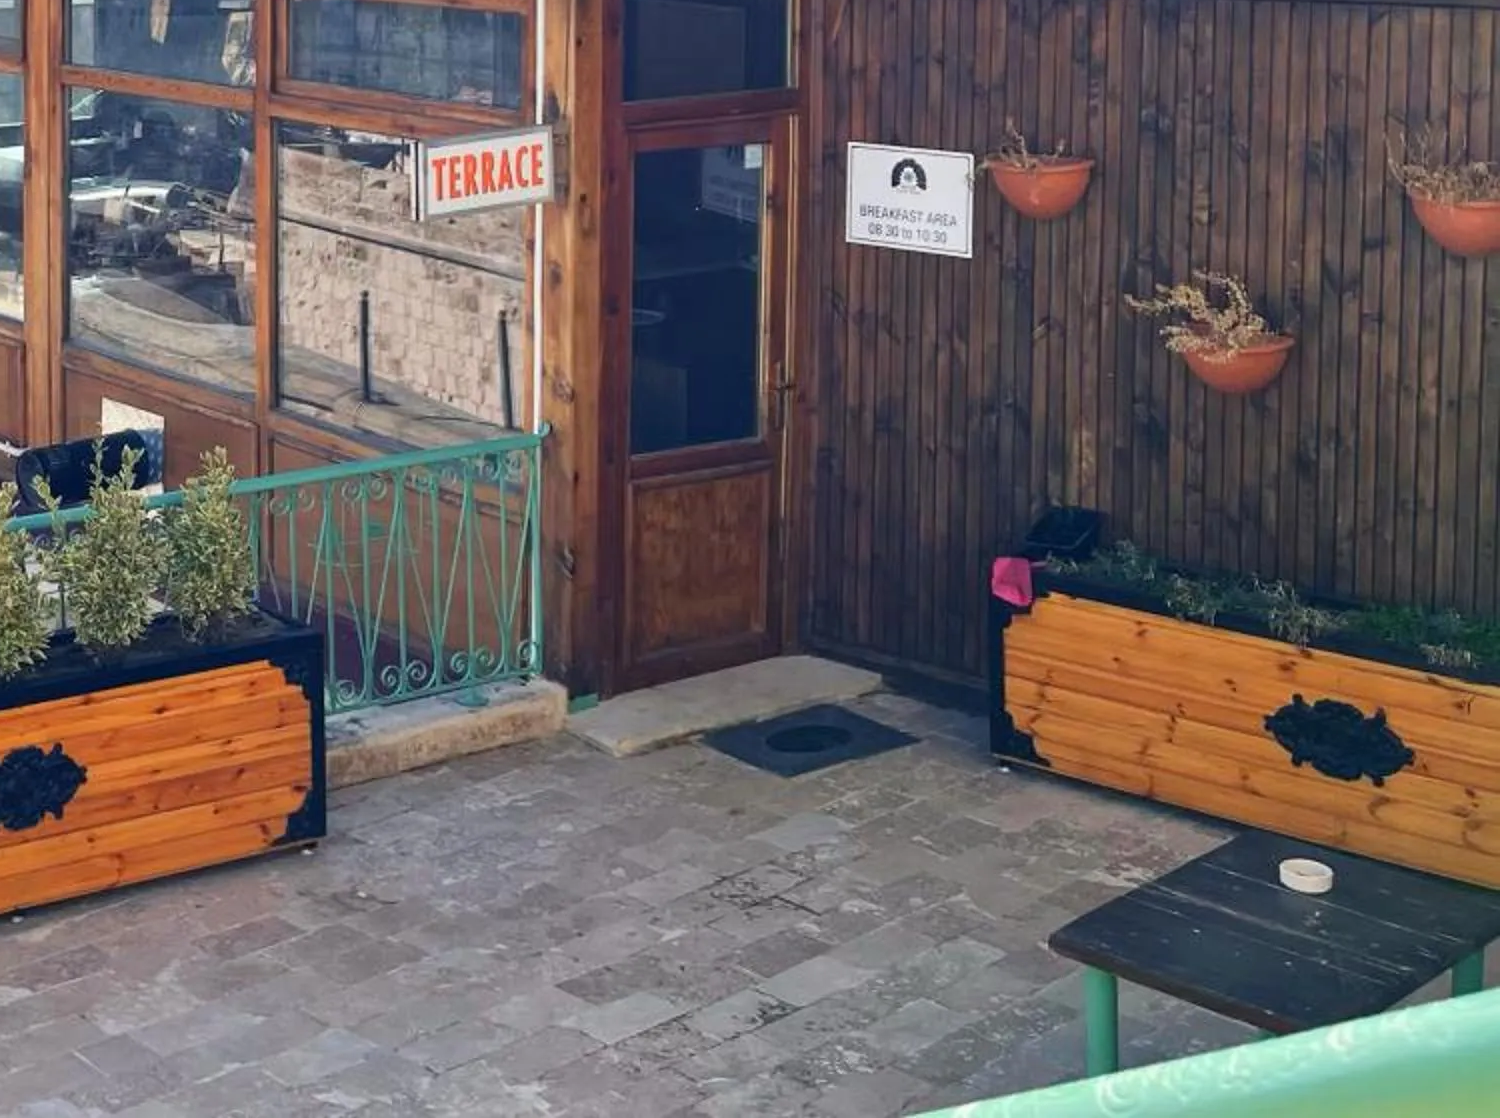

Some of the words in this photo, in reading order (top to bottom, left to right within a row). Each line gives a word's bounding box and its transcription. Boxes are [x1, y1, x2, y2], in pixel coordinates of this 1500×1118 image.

[431, 144, 544, 201] TERRACE
[860, 204, 923, 223] BREAKFAST
[927, 211, 957, 227] AREA
